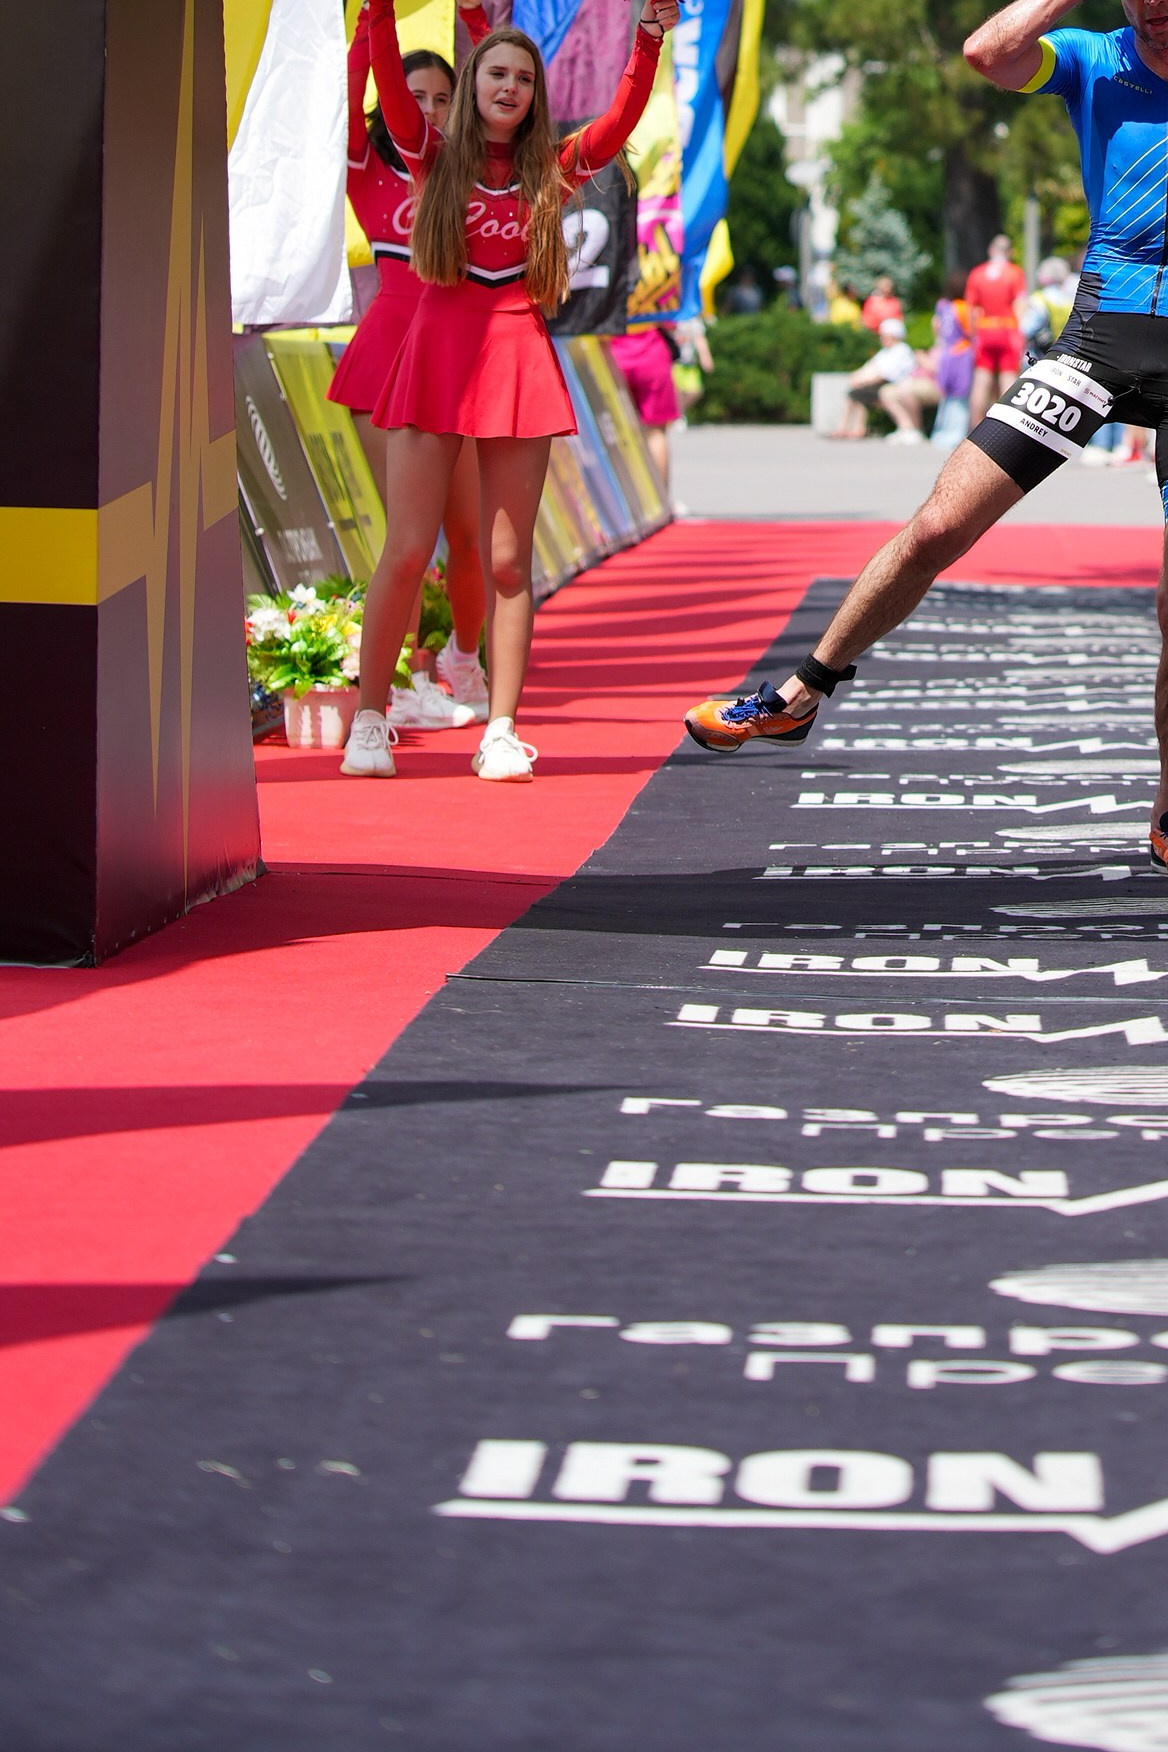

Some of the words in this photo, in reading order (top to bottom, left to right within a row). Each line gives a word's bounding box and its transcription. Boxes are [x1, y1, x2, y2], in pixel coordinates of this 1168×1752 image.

[1010, 382, 1082, 432] 3020
[1020, 418, 1049, 438] ANDREY
[797, 793, 1037, 806] IRON
[762, 866, 1039, 877] IRON
[707, 949, 1040, 973] IRON
[673, 1003, 1042, 1032] IRON
[600, 1160, 1069, 1198] IRON
[457, 1438, 1106, 1512] IRON
